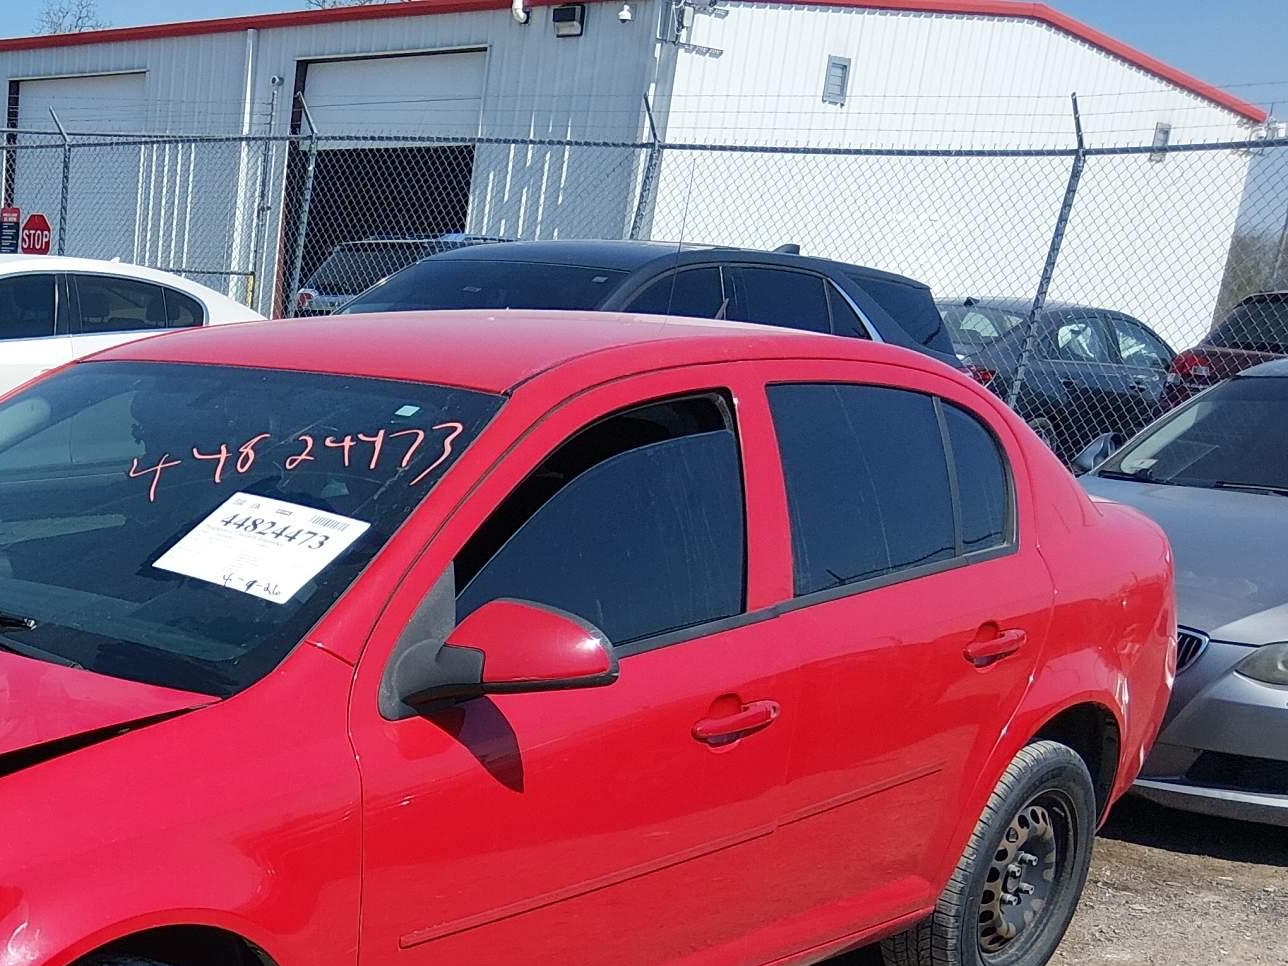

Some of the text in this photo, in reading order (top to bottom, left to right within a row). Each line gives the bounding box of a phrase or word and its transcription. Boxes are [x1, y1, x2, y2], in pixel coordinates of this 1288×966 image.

[22, 229, 50, 250] STOP
[128, 422, 464, 503] 44824473
[220, 513, 330, 550] 44824473
